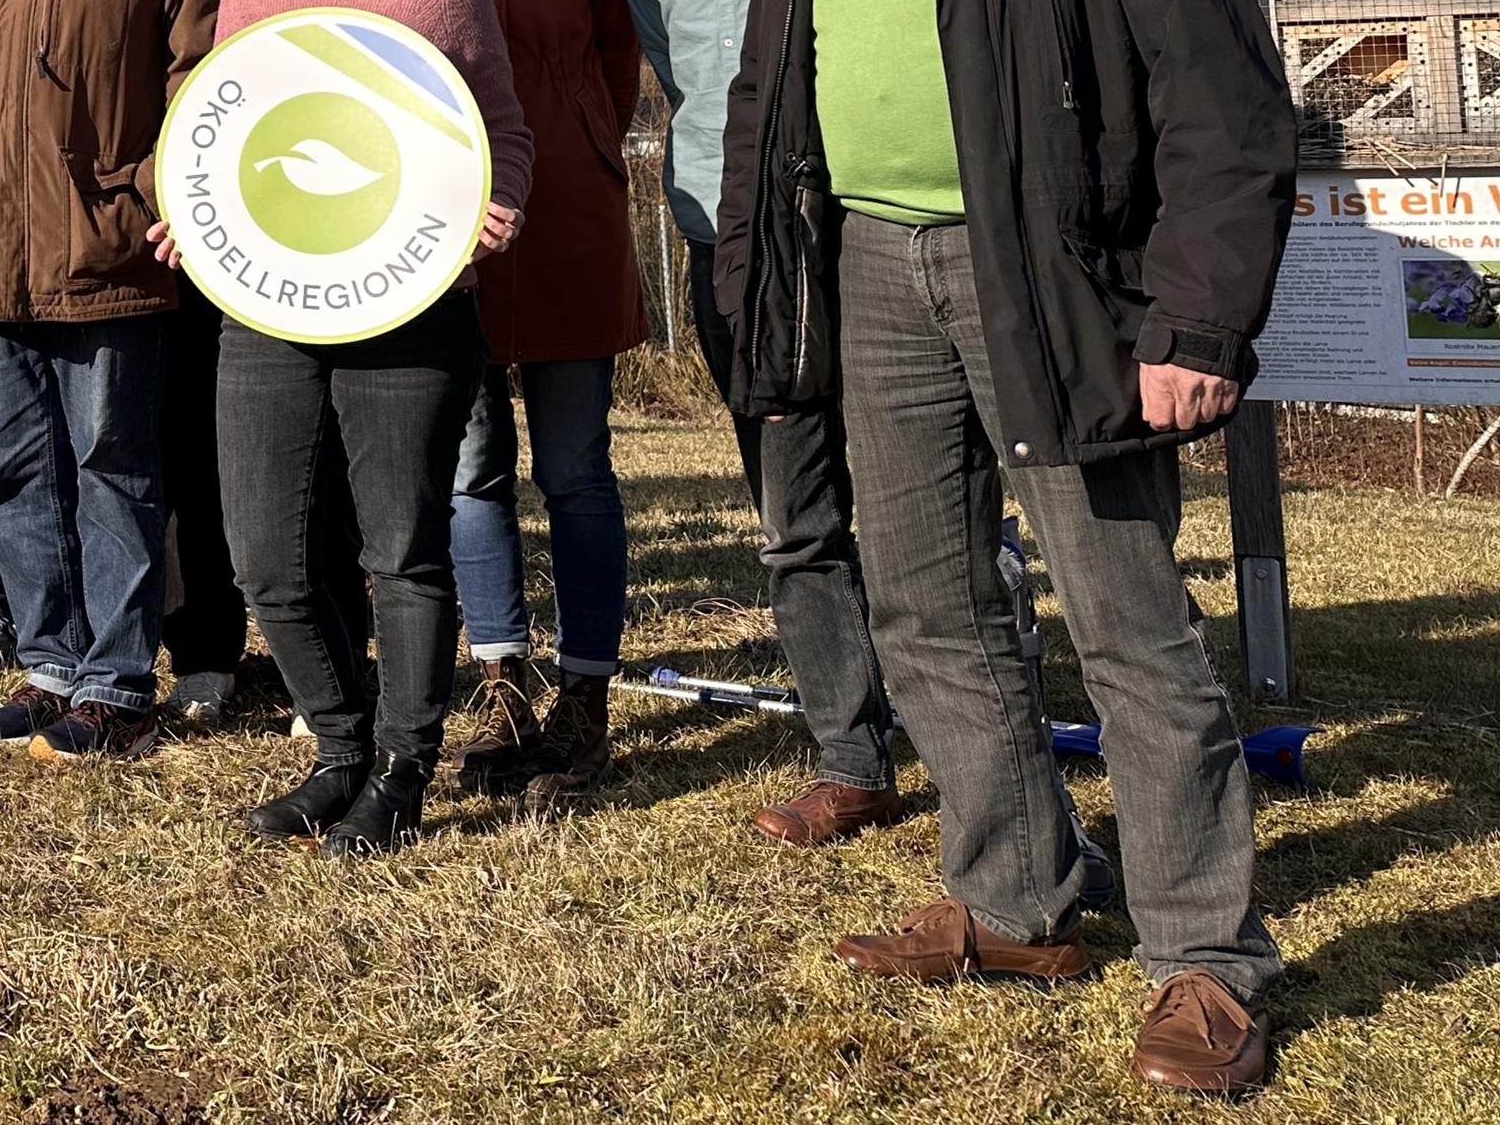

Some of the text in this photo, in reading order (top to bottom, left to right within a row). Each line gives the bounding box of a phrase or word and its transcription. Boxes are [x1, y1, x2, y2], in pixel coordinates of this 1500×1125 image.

[185, 79, 447, 311] ÖKO-MODELLREGIONEN
[1328, 185, 1387, 217] ist
[1400, 184, 1473, 215] ein
[1397, 235, 1474, 249] Welche
